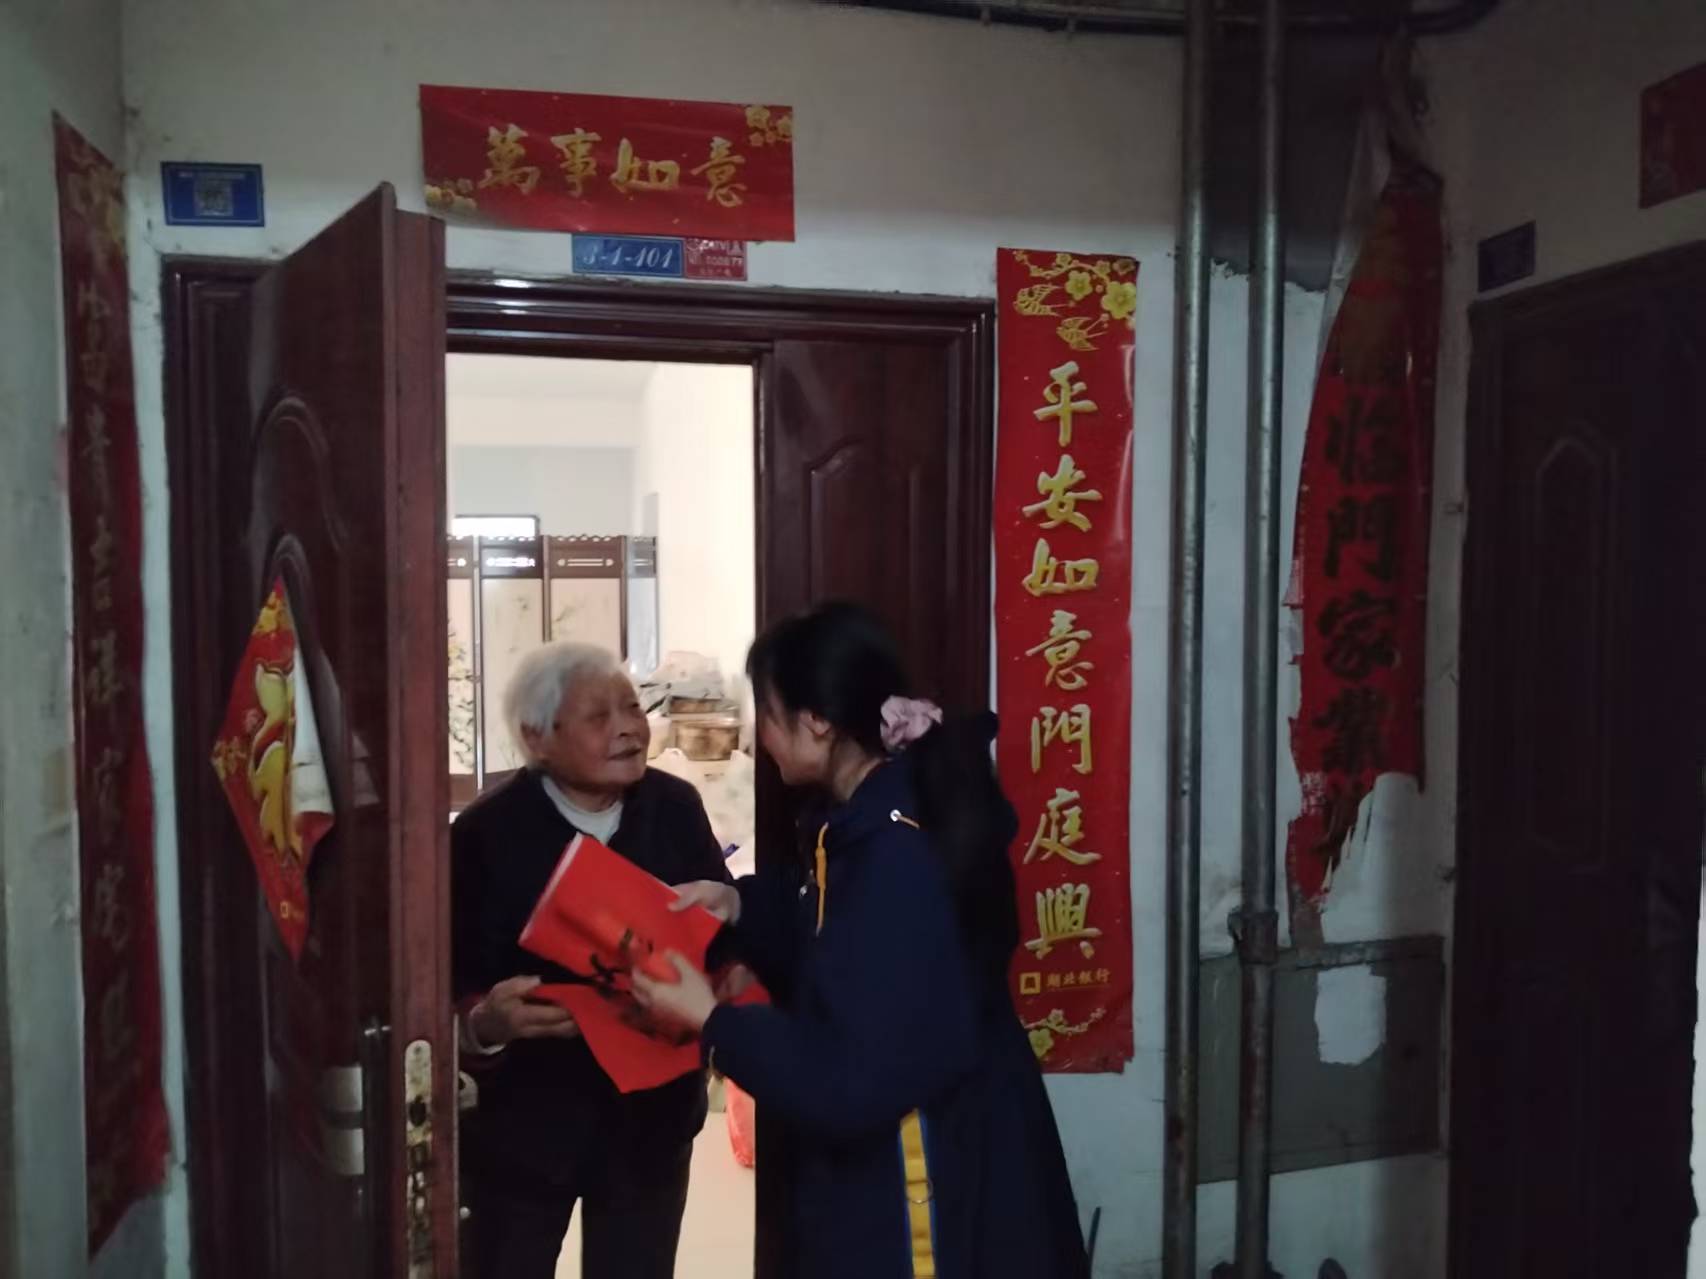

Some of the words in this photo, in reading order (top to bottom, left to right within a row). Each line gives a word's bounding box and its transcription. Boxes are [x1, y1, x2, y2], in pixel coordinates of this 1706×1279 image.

[478, 123, 747, 208] 萬事如意
[1022, 361, 1103, 960] 平安如意門庭興
